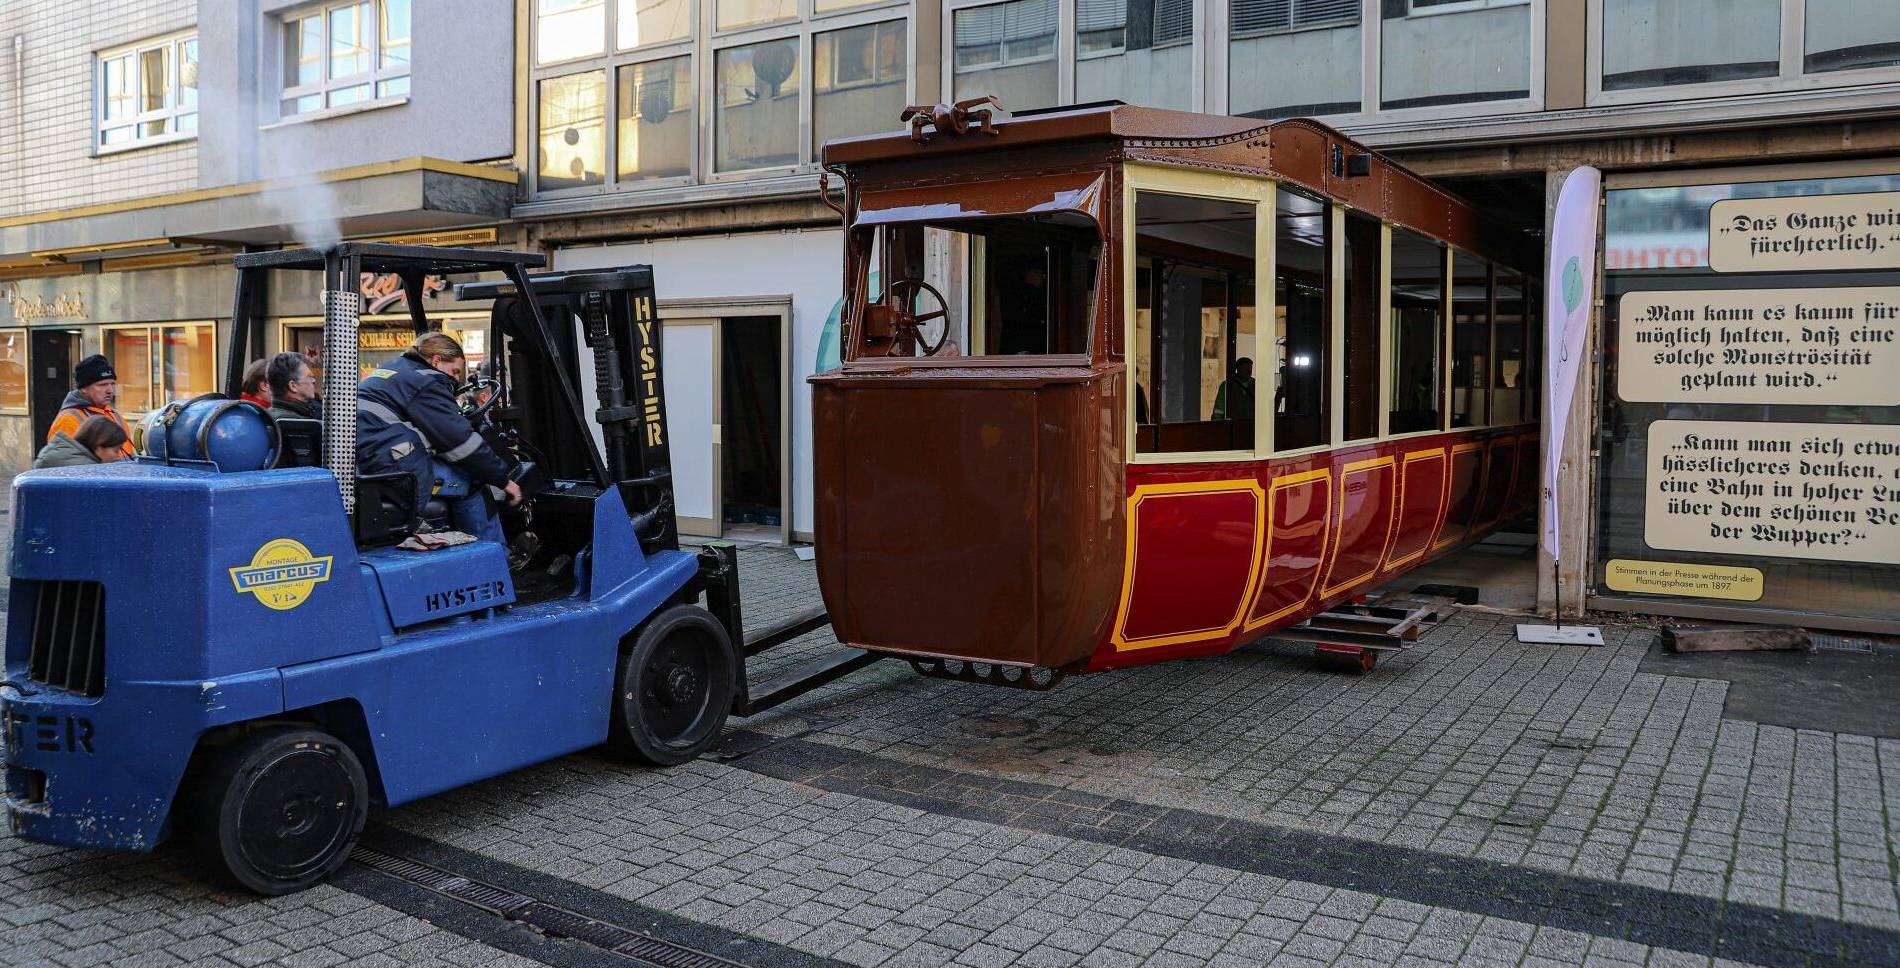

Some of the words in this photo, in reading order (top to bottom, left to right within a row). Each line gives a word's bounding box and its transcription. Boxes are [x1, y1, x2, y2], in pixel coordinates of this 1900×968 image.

[1786, 211, 1857, 233] Ganze
[1704, 304, 1753, 321] kann
[1763, 305, 1786, 321] es
[1795, 303, 1853, 321] kaum
[1864, 302, 1900, 323] für
[1635, 327, 1711, 348] möglich
[1720, 327, 1791, 346] halten,
[1801, 326, 1840, 347] daß
[1850, 326, 1895, 343] eine
[1654, 349, 1715, 369] solche
[1723, 348, 1872, 366] Monströsität
[635, 296, 662, 447] HYSTER
[1681, 372, 1757, 392] geplant
[1748, 440, 1791, 453] man
[1801, 437, 1844, 457] sich
[1662, 455, 1790, 477] hässlicheres
[1800, 459, 1883, 480] denken,
[1660, 477, 1699, 494] eine
[1706, 477, 1764, 500] Bahn
[1773, 480, 1793, 498] in
[1802, 482, 1863, 503] hoher
[1668, 500, 1712, 516] über
[1721, 502, 1761, 519] dem
[1770, 503, 1856, 524] schönen
[1711, 522, 1743, 540] der
[266, 557, 299, 566] MONTAGE
[241, 563, 324, 586] marcus
[1615, 565, 1648, 575] Stimmen
[1649, 568, 1657, 577] in
[1659, 569, 1672, 577] der
[1675, 570, 1699, 579] Presse
[1702, 573, 1738, 582] während
[1740, 574, 1754, 583] der
[1636, 576, 1694, 589] Planungsphase
[425, 580, 506, 613] HYSTER
